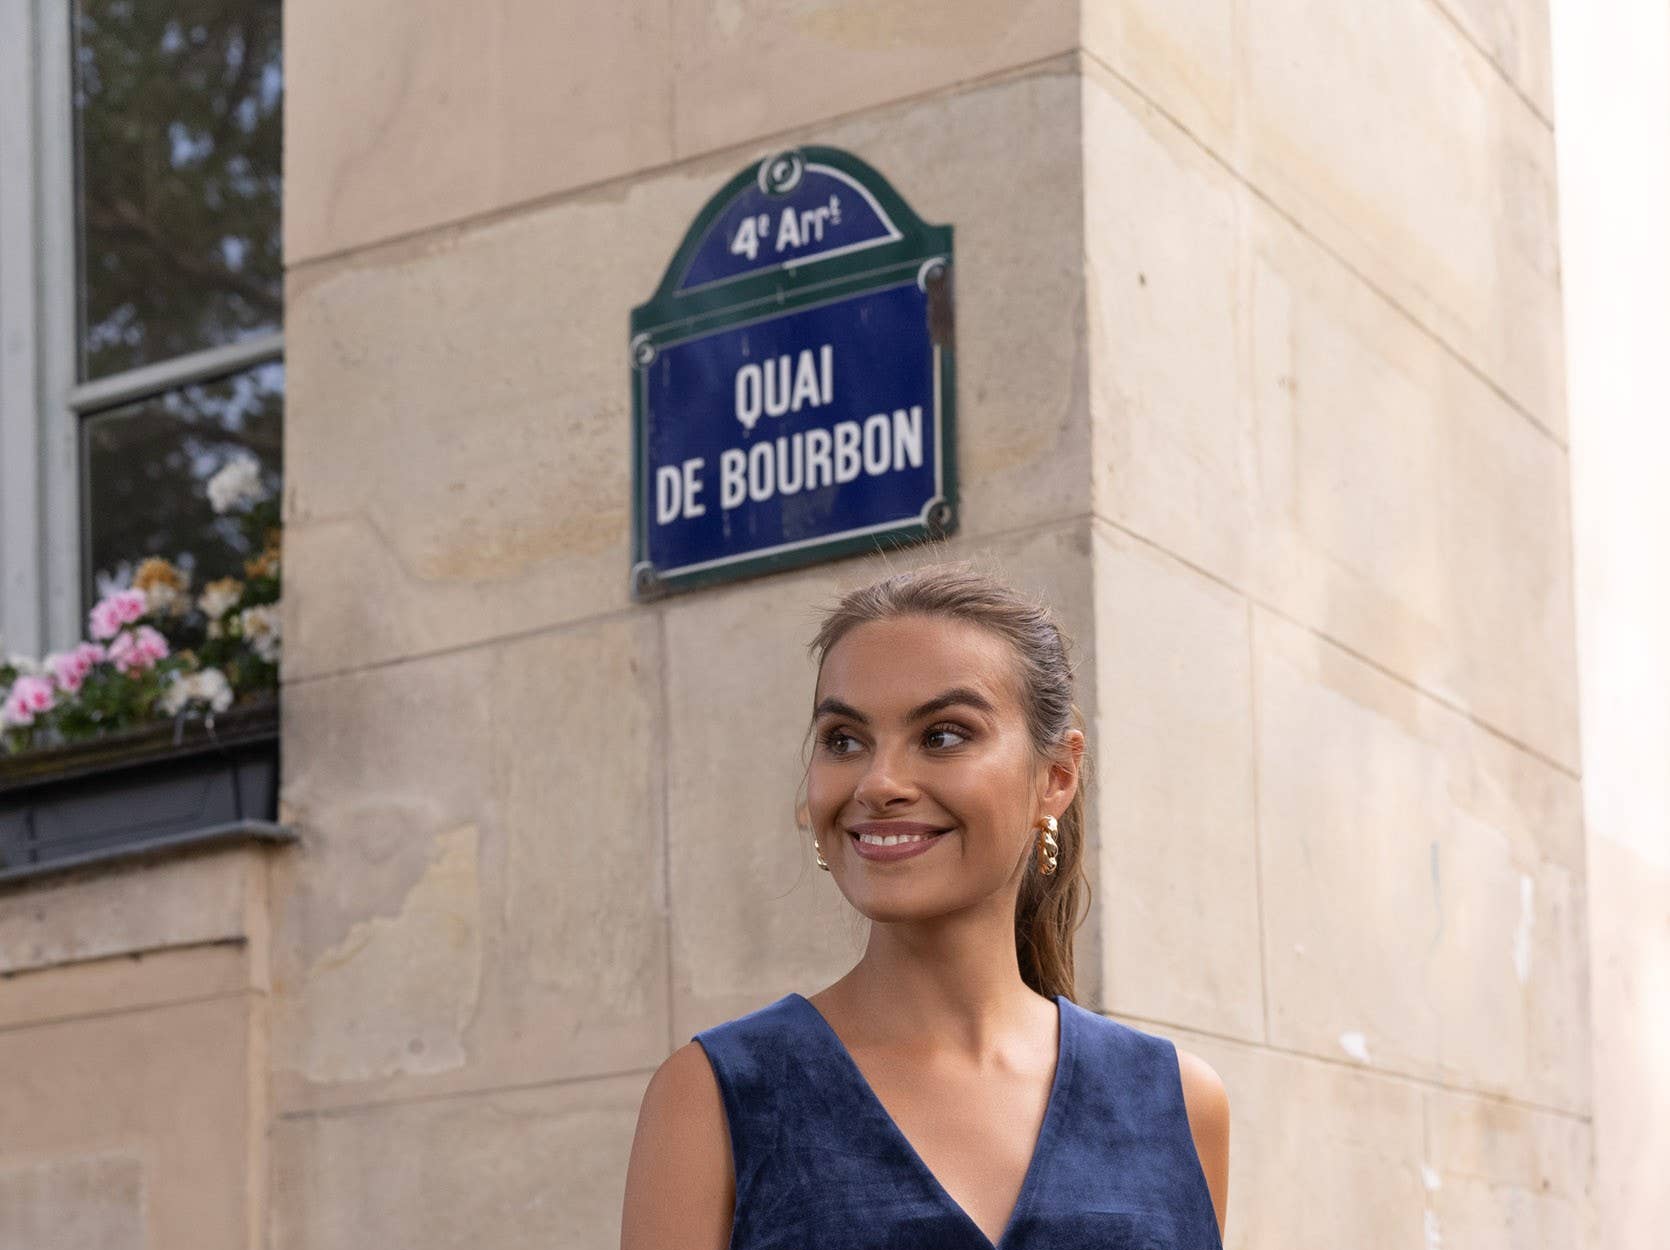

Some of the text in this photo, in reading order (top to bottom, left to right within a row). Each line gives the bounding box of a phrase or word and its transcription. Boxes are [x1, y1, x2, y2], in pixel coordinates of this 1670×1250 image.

[734, 344, 834, 429] QUAI
[656, 405, 923, 525] DE BOURBON
